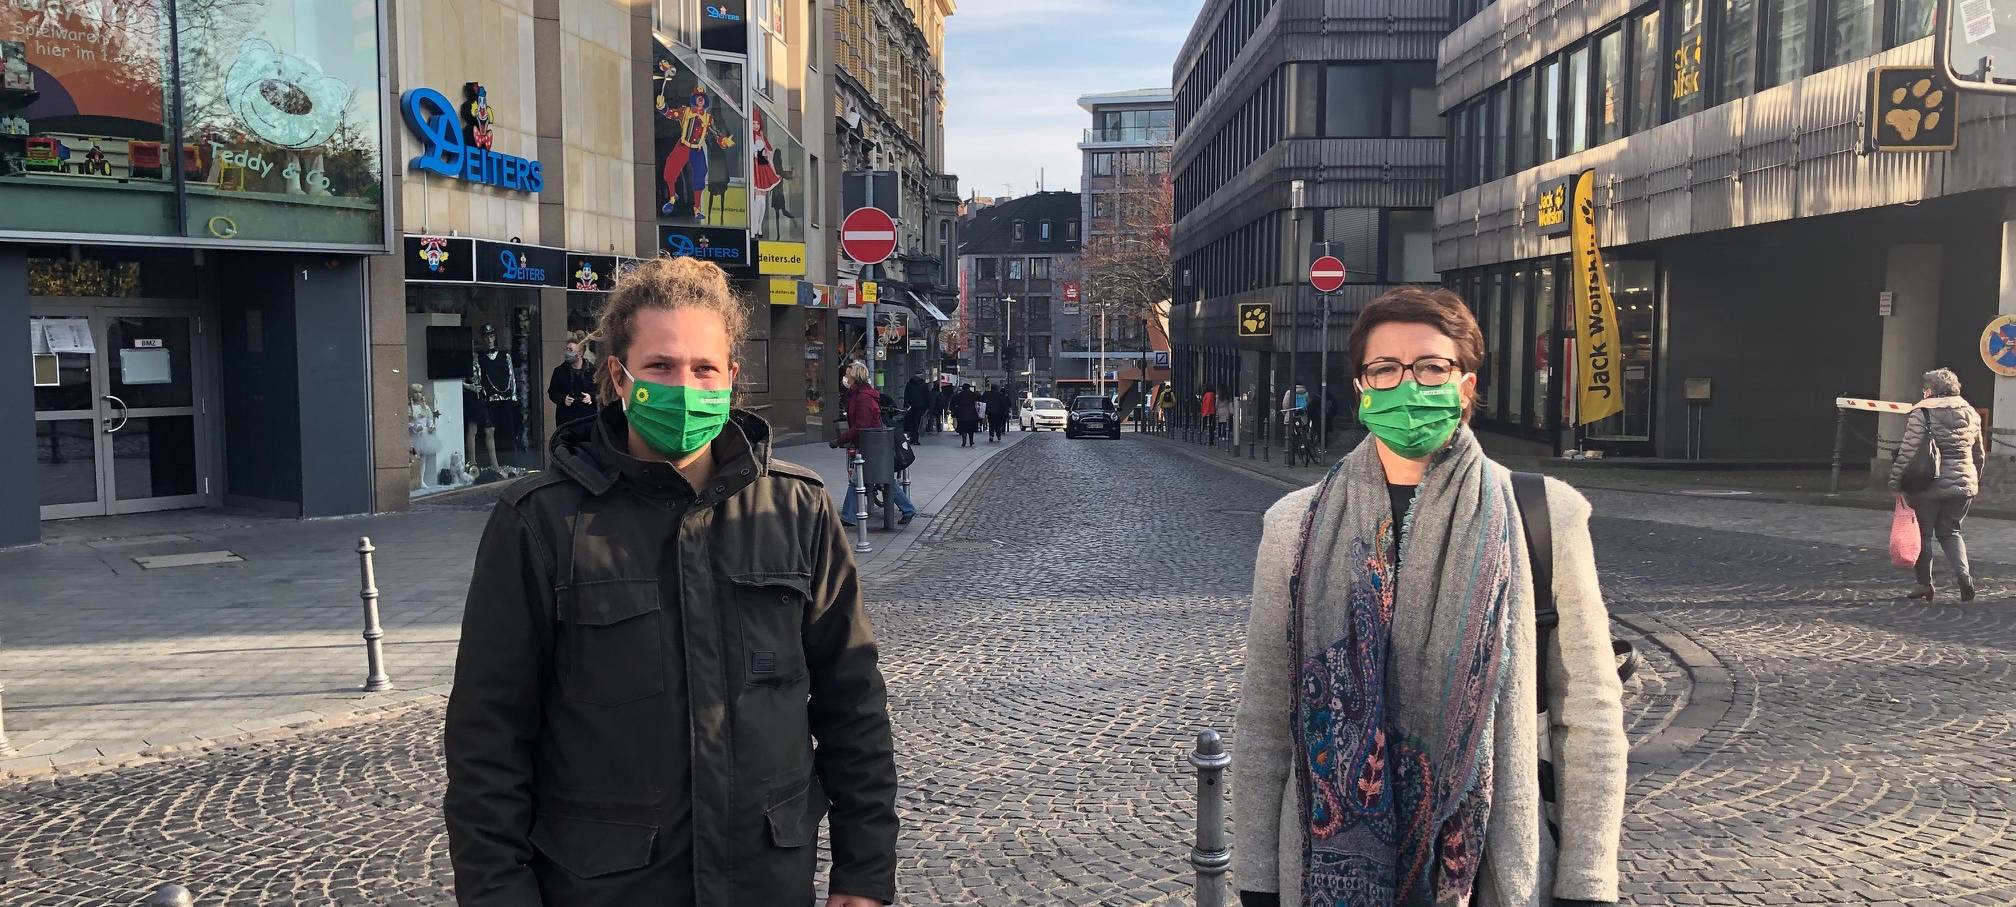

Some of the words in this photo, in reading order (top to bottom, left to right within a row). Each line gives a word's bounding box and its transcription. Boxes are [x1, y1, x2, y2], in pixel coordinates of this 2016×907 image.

[15, 21, 109, 45] Spielwaren
[36, 39, 71, 58] hier
[73, 43, 95, 61] im
[400, 87, 545, 193] DEITERS
[207, 140, 274, 179] Teddy
[282, 163, 297, 179] &
[306, 169, 336, 193] Co.
[1539, 189, 1554, 210] Jack
[1538, 206, 1564, 227] Wolfskin
[667, 234, 740, 259] DEITERS
[758, 253, 802, 264] deiters.de
[302, 270, 308, 280] 1
[500, 250, 545, 281] DEITERS
[1588, 342, 1611, 399] Jack
